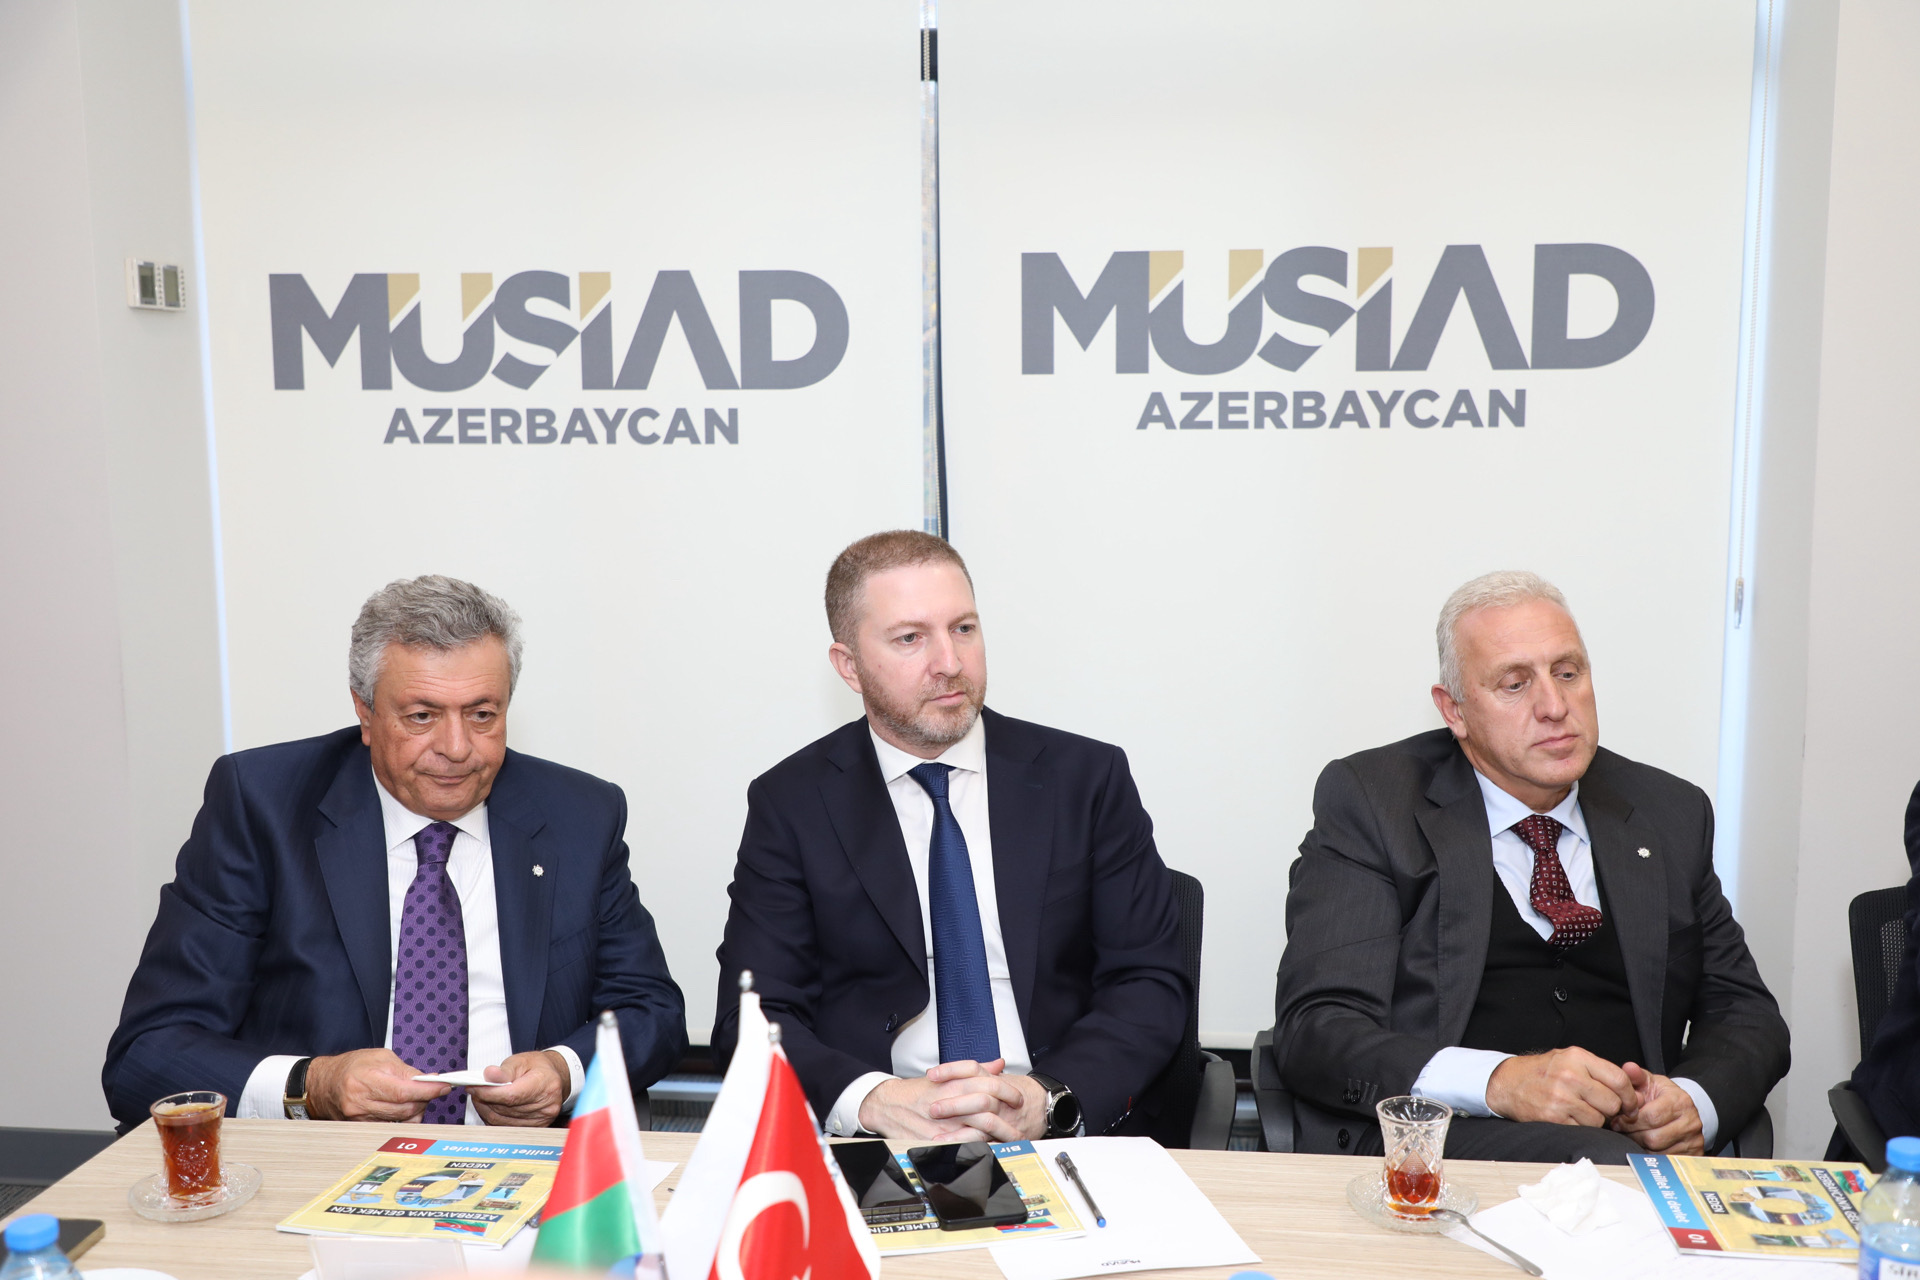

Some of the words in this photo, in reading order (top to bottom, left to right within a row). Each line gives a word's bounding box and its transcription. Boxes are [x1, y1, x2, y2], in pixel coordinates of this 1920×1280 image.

[1136, 389, 1526, 430] AZERBAYCAN
[384, 407, 739, 445] AZERBAYCAN
[396, 1142, 418, 1151] 01
[442, 1144, 488, 1154] devlet
[450, 1161, 491, 1169] NEDEN
[1649, 1168, 1671, 1189] millet
[1661, 1190, 1678, 1200] iki
[1703, 1192, 1725, 1213] NEDEN
[357, 1207, 406, 1217] GELMEK
[407, 1210, 500, 1221] AZERBAYCAN'A
[1666, 1200, 1691, 1223] devlet
[896, 1221, 940, 1232] ELMEK
[1687, 1233, 1708, 1244] 01
